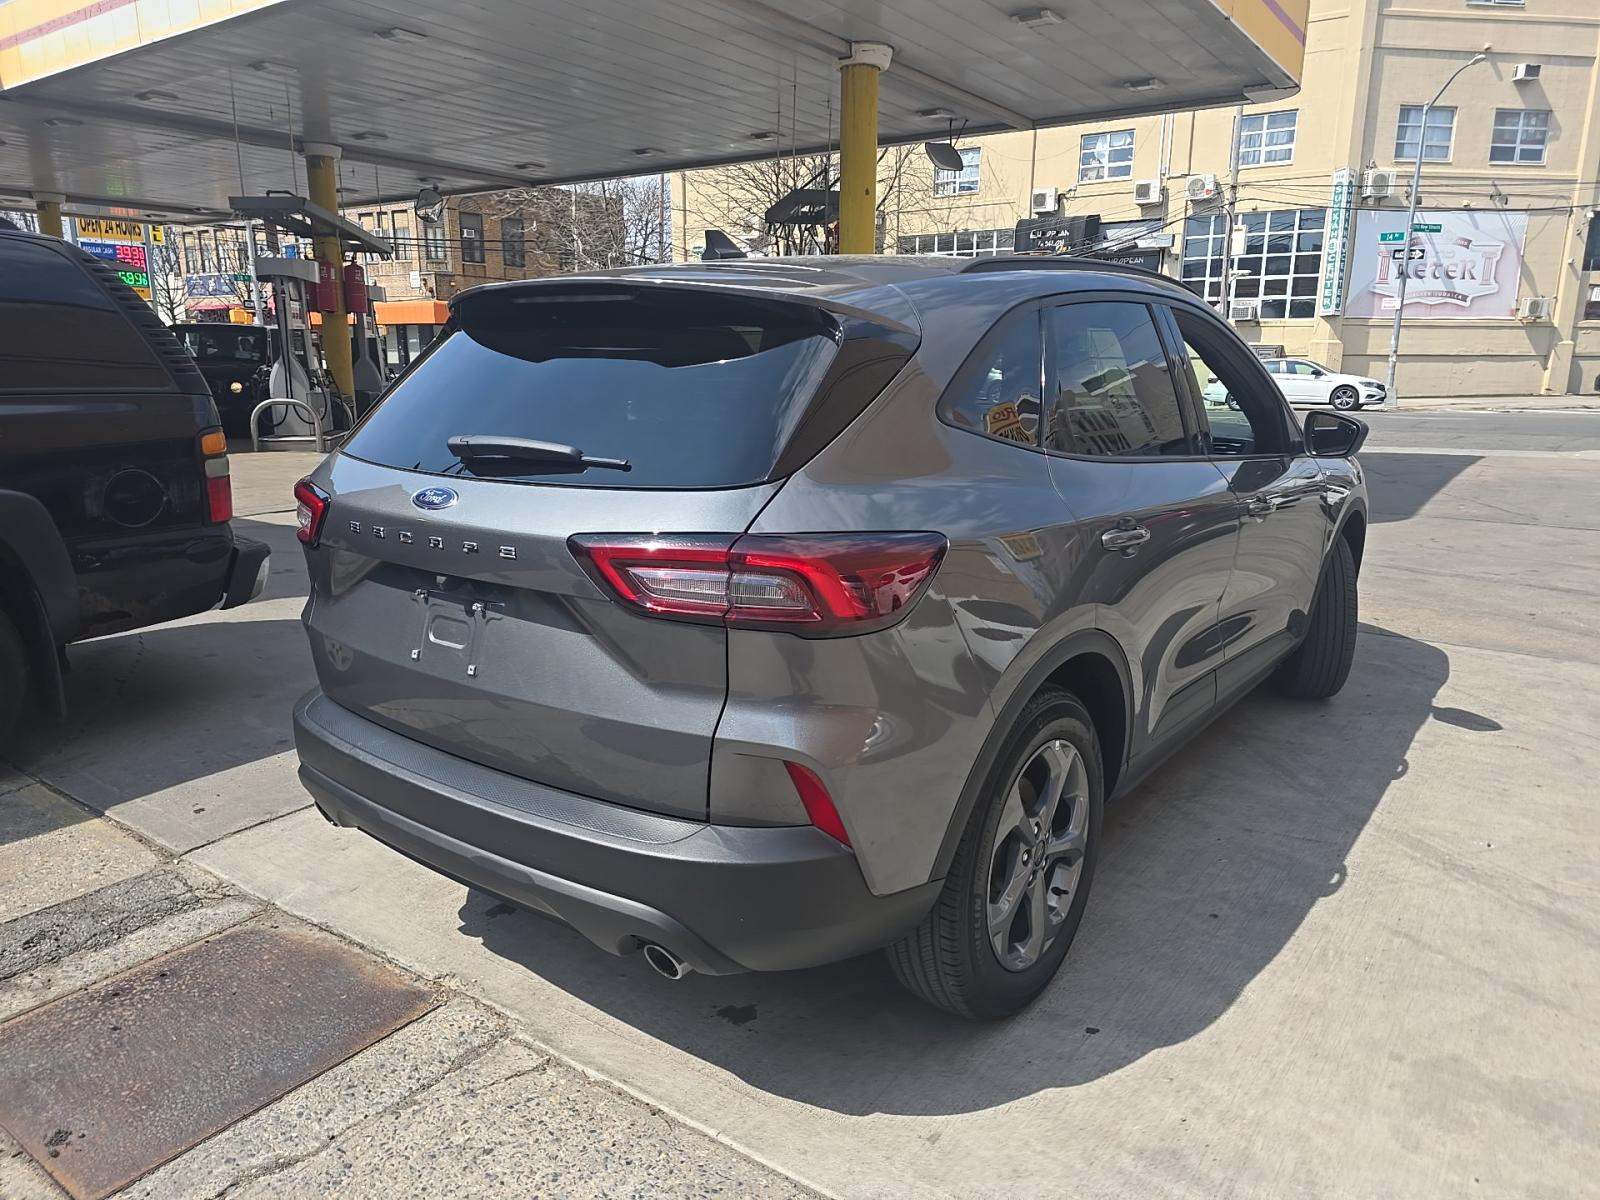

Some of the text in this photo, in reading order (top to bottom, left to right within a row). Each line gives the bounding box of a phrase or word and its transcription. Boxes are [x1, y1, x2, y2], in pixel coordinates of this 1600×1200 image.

[79, 218, 101, 233] OPEN
[105, 220, 114, 234] 24
[420, 489, 448, 503] Ford
[349, 520, 517, 562] ESCAPE
